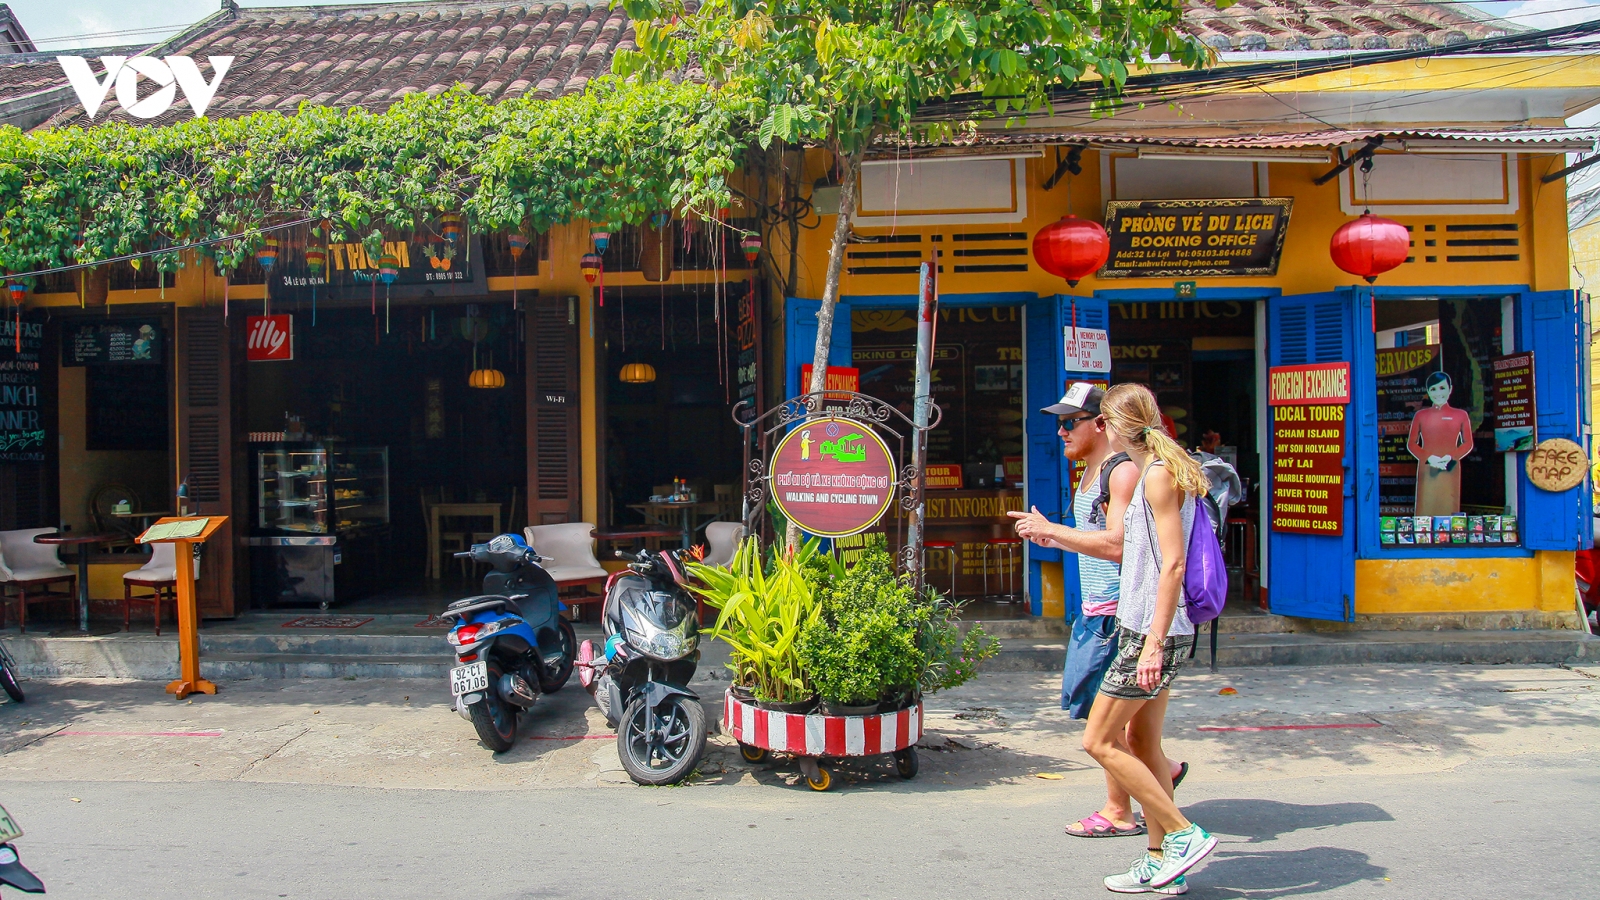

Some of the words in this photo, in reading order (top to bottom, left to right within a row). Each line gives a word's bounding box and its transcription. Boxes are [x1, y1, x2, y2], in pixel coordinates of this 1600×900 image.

[1120, 212, 1176, 233] PHÒNG
[1182, 211, 1203, 232] VÉ
[1207, 215, 1231, 231] DU
[1234, 214, 1275, 233] LỊCH
[1131, 235, 1202, 248] BOOKING
[1207, 234, 1258, 246] OFFICE
[283, 275, 292, 286] 34
[1180, 284, 1191, 294] 32
[248, 319, 287, 355] illy
[1081, 341, 1098, 350] BATTERY
[1081, 351, 1092, 359] FILM
[1092, 360, 1103, 369] CARD
[1271, 371, 1304, 401] FOREIGN
[1305, 368, 1347, 399] EXCHANGE
[1274, 406, 1306, 422] LOCAL
[1309, 405, 1344, 421] TOURS
[1278, 429, 1305, 438] CHAM
[1307, 429, 1340, 438] ISLAND
[1277, 444, 1289, 453] MY
[1290, 444, 1304, 453] SON
[1305, 444, 1340, 454] HOLYLAND
[1297, 459, 1313, 468] LAI
[1531, 466, 1571, 481] MAP
[800, 472, 810, 488] BỘ
[810, 472, 821, 487] VÀ
[821, 475, 831, 487] XE
[831, 473, 856, 488] KHÔNG
[1277, 474, 1304, 484] MARBLE
[1305, 475, 1341, 485] MOUNTAIN
[785, 491, 815, 503] WALKING
[815, 492, 830, 503] AND
[830, 493, 857, 505] CYCLING
[858, 494, 879, 505] TOWN
[1277, 488, 1303, 498] RIVER
[1305, 489, 1329, 499] TOUR
[1276, 503, 1306, 513] FISHING
[1308, 504, 1328, 514] TOUR
[1276, 518, 1311, 529] COOKING
[1312, 519, 1338, 530] CLASS
[454, 676, 486, 694] 067.06
